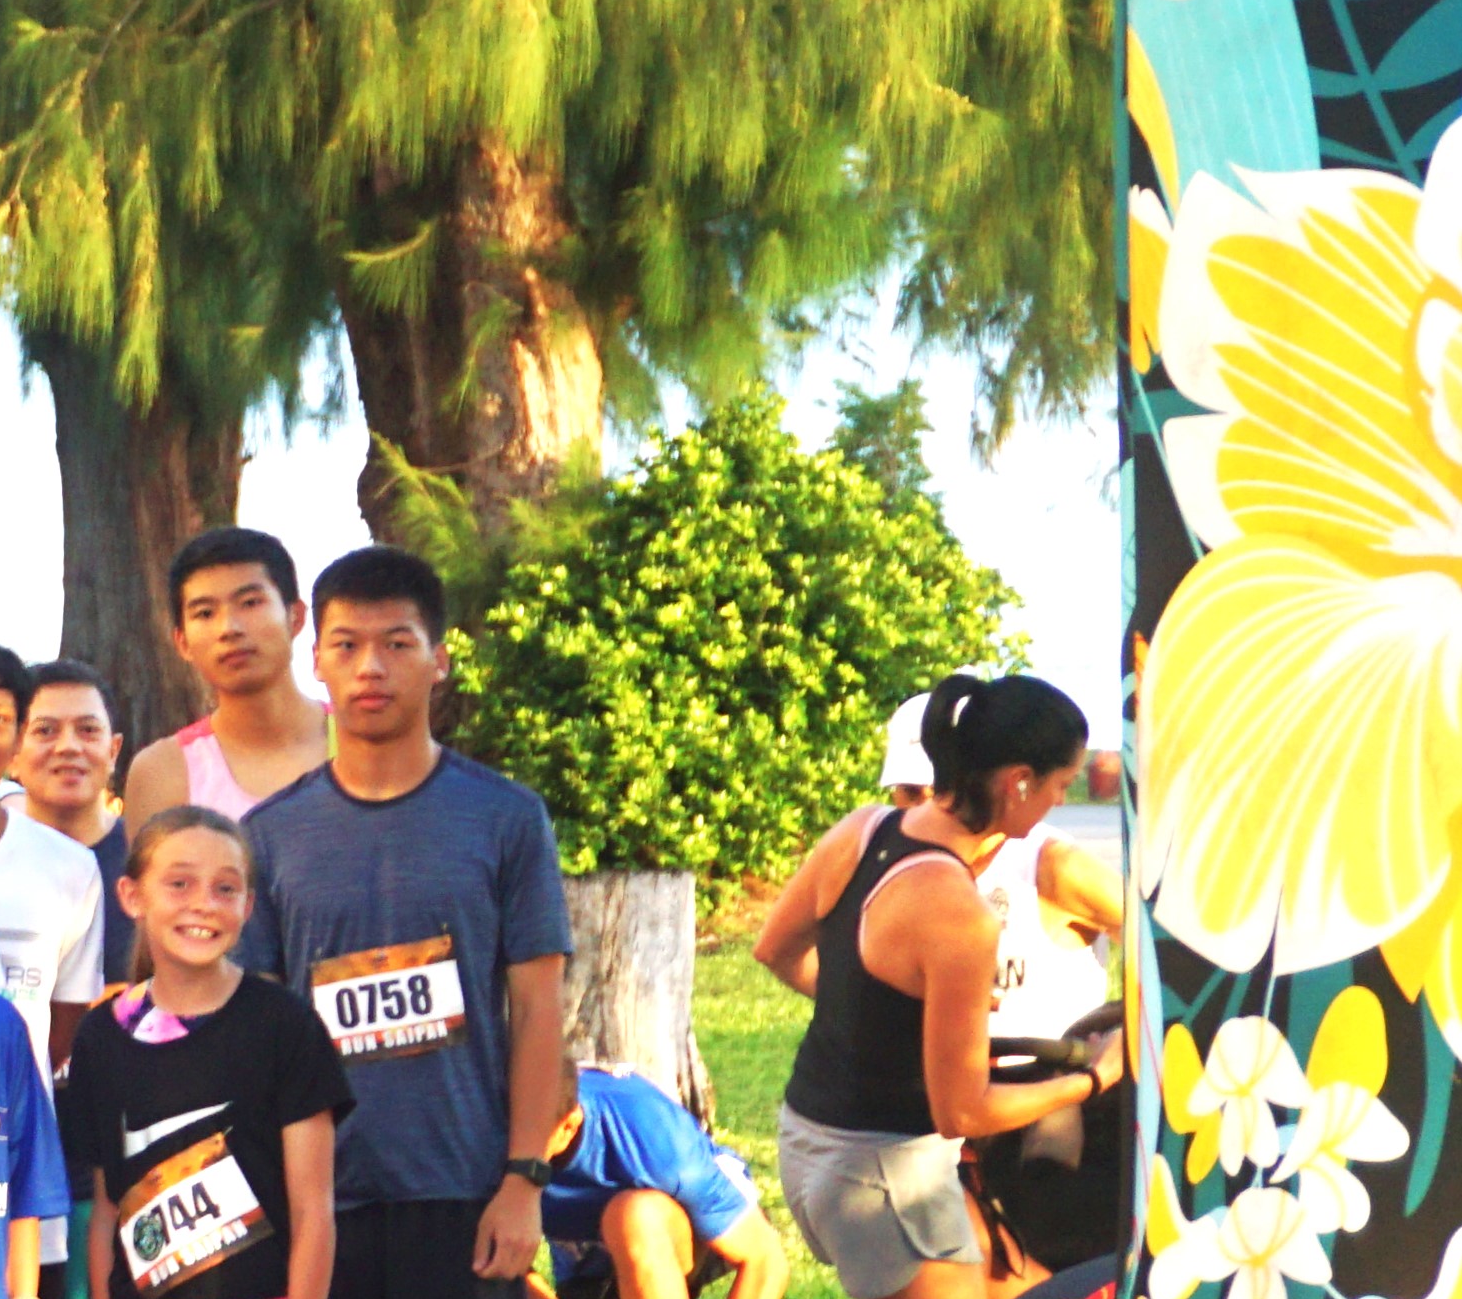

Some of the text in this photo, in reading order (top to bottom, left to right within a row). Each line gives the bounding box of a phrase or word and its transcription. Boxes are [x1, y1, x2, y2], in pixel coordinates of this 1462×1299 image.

[335, 974, 433, 1029] 0758
[340, 1019, 448, 1056] RUN SAIPAN
[148, 1218, 248, 1287] RUN SAIPAN
